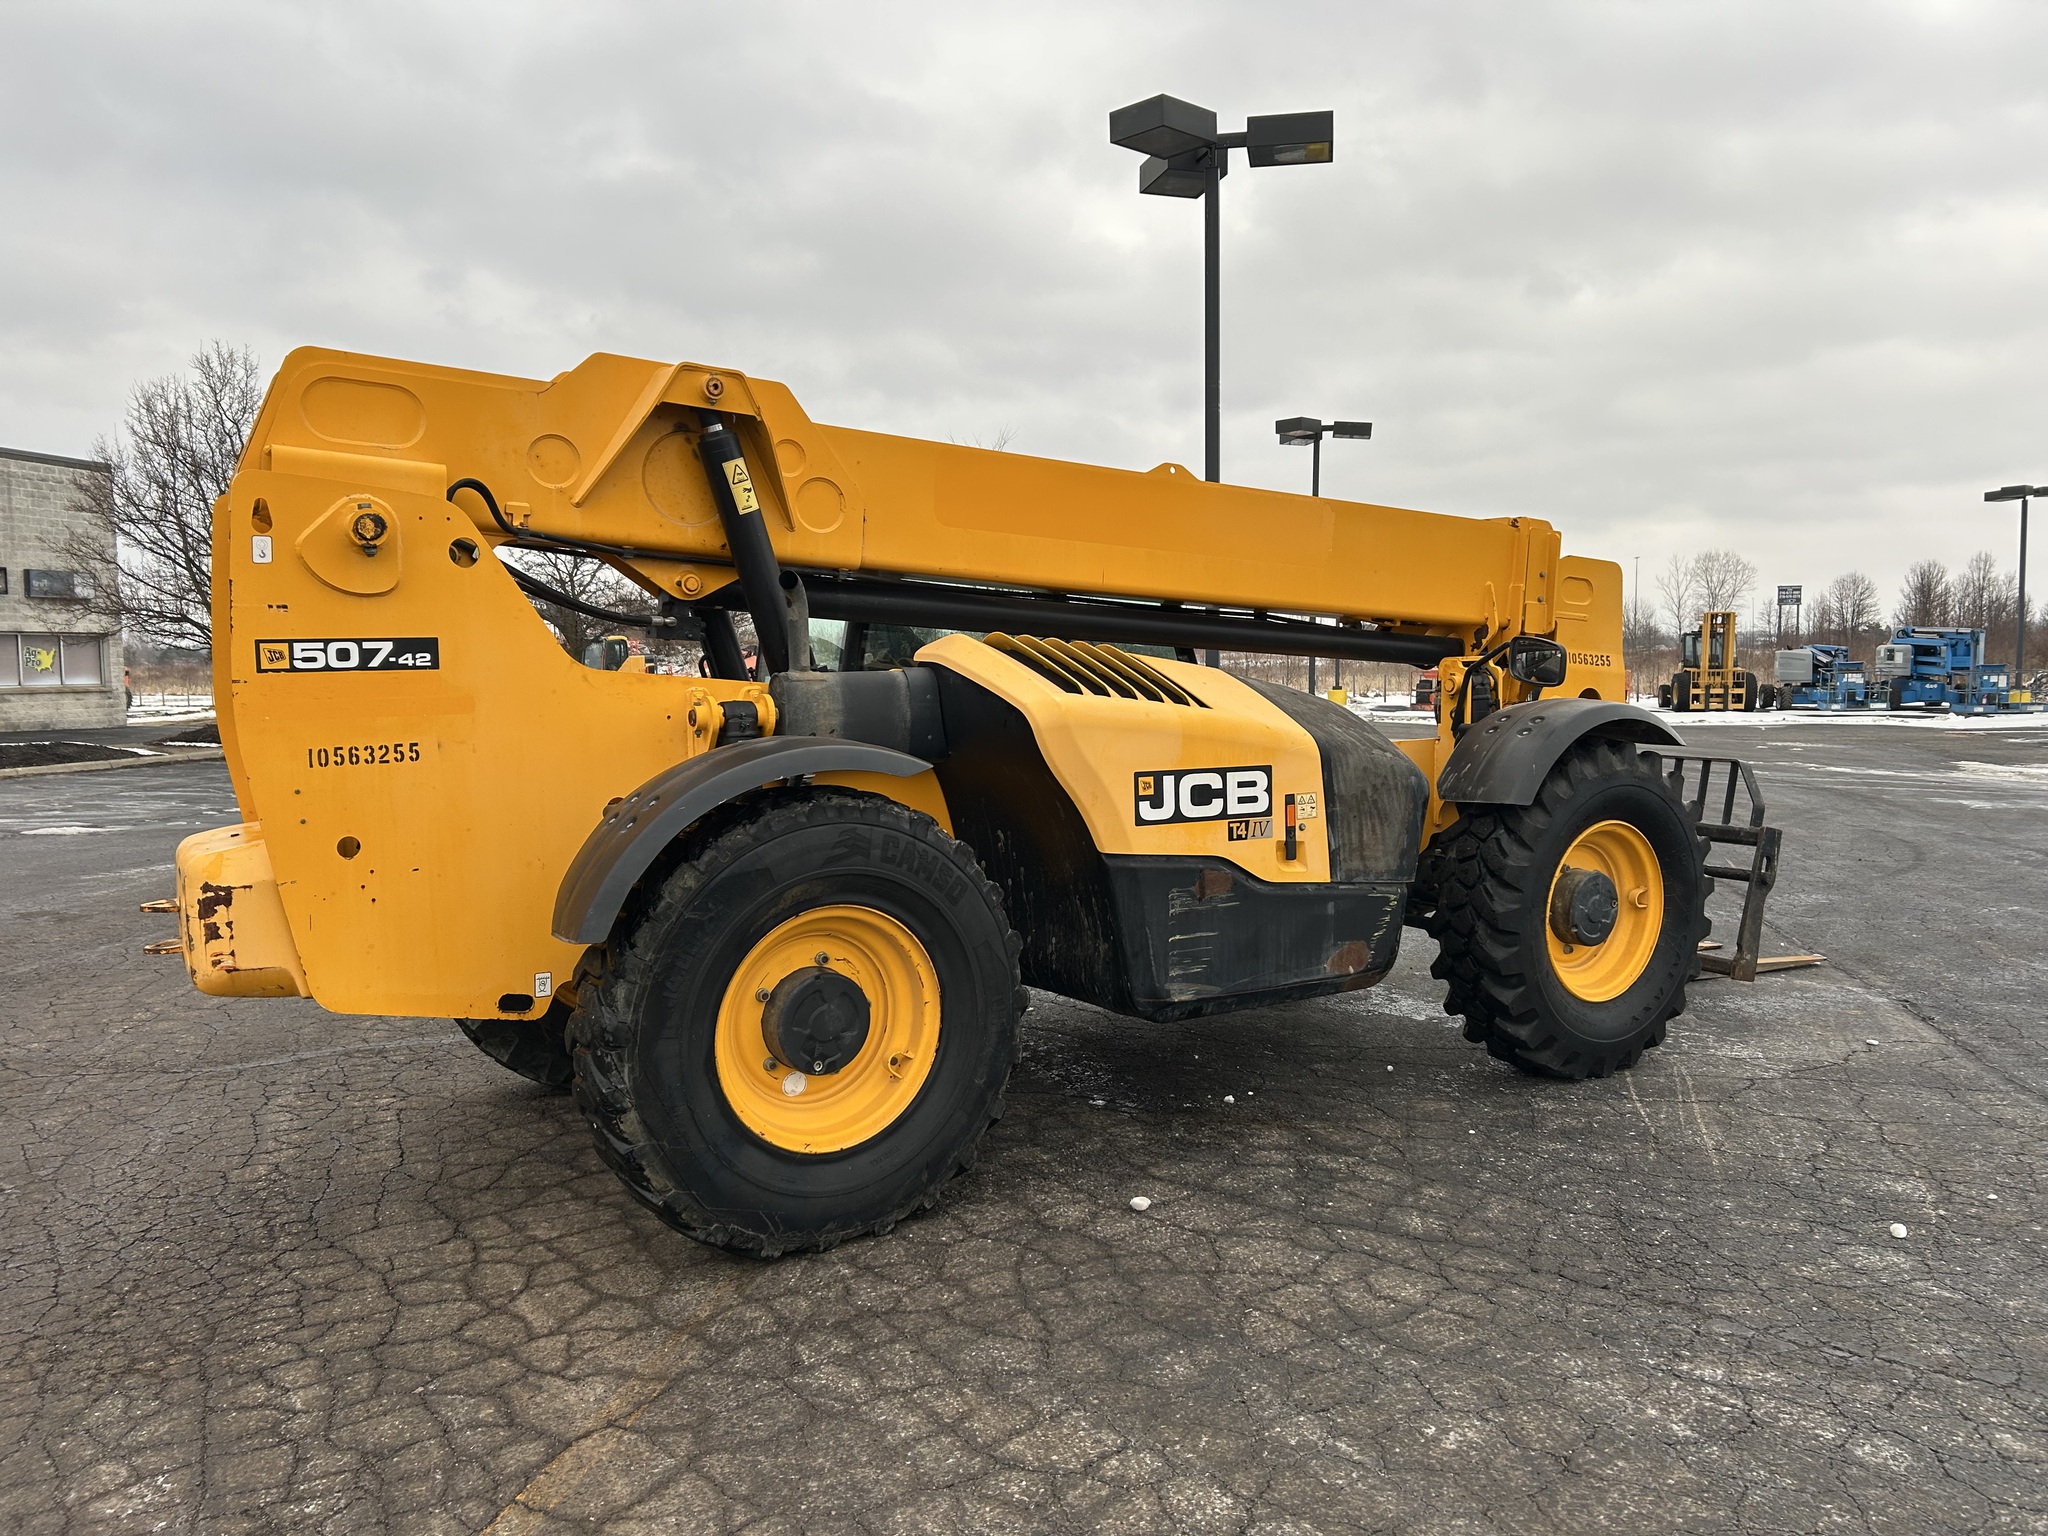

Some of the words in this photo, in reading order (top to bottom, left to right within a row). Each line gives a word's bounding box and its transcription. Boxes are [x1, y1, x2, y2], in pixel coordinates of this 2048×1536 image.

[24, 647, 40, 658] Ag-
[24, 657, 41, 667] Pro
[267, 649, 285, 663] JCB
[292, 641, 432, 669] 507-42
[1568, 652, 1611, 667] 10563255
[308, 742, 420, 768] 10563255
[1138, 770, 1270, 821] JCB
[879, 834, 969, 907] CAMSO
